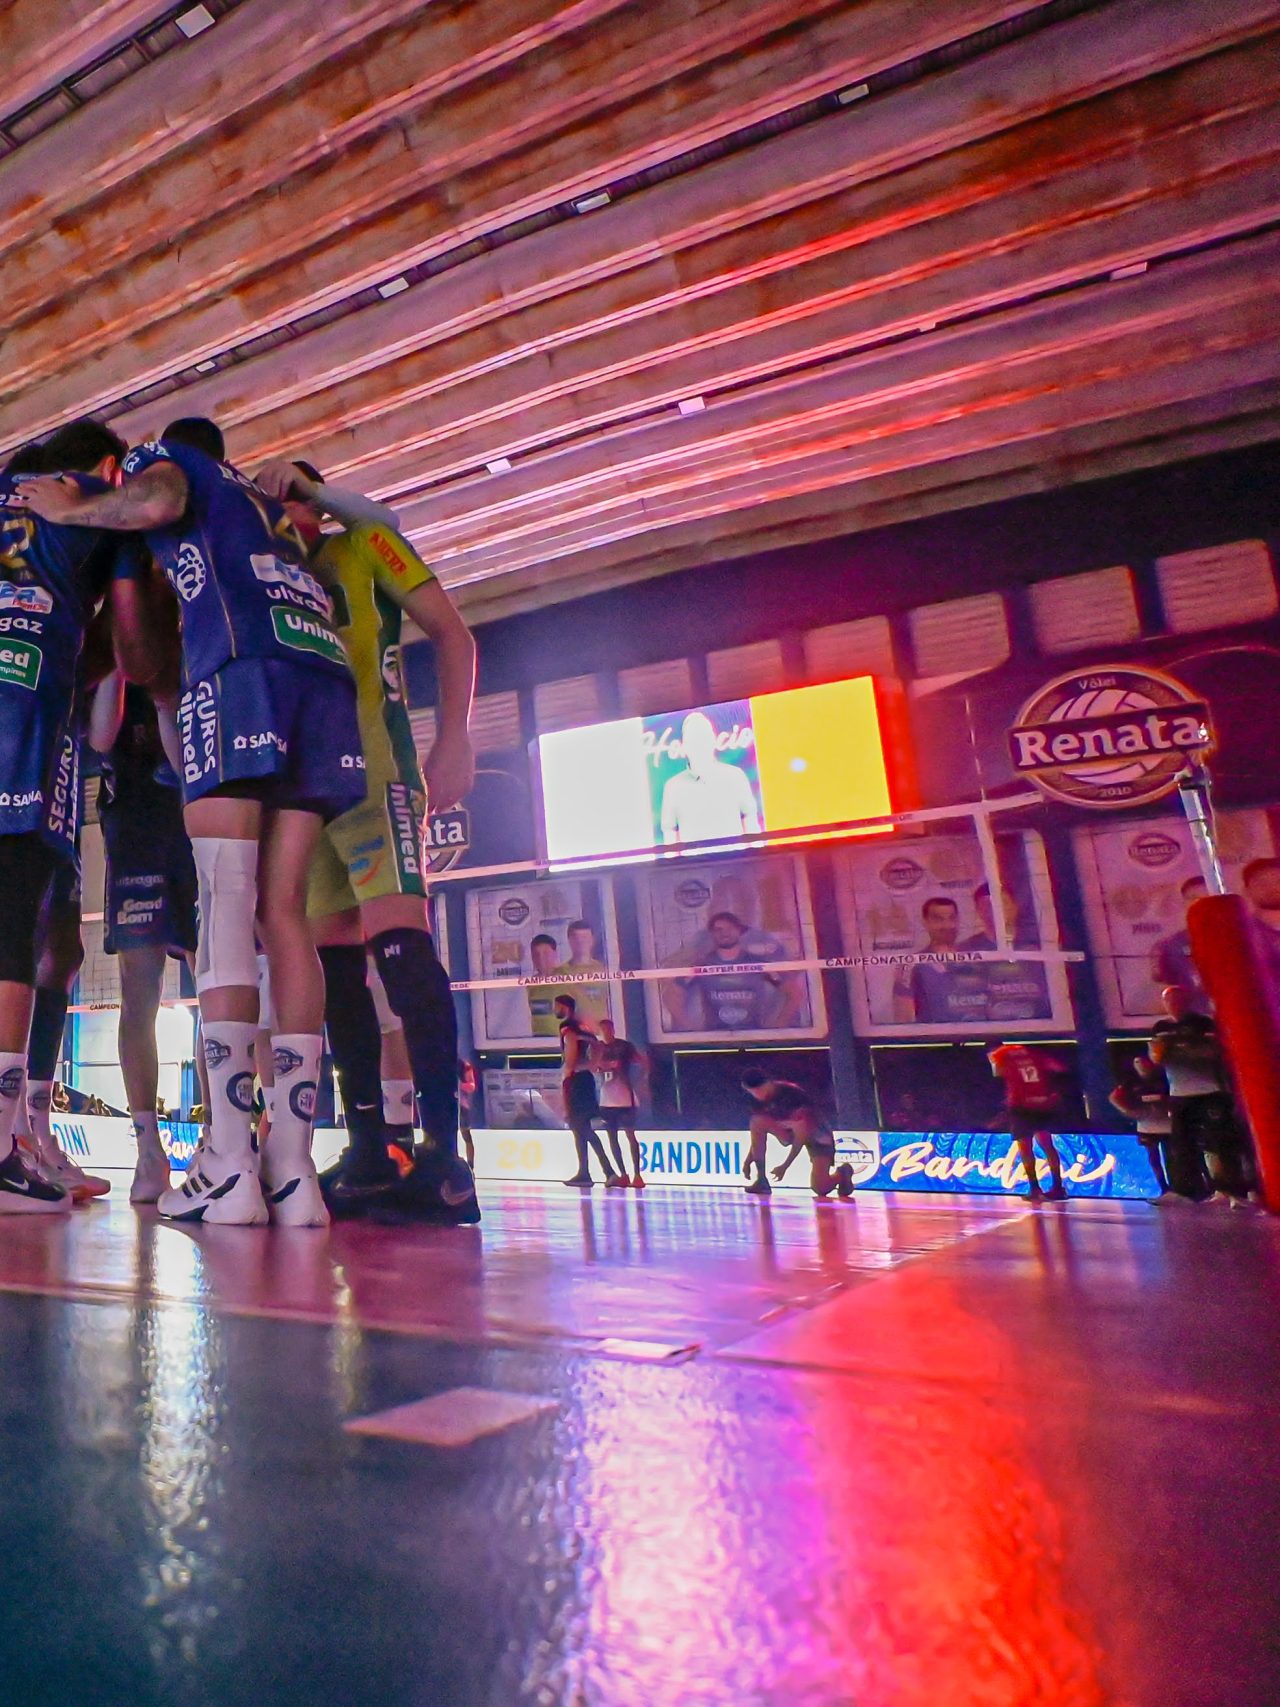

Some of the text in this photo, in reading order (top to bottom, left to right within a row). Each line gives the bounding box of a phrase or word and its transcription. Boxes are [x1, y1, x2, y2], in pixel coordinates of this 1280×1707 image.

[1013, 715, 1210, 767] Renata
[826, 952, 983, 967] CAMPEONATO PAULISTA
[517, 970, 636, 986] CAMPEONATO PAULISTA
[496, 1138, 543, 1171] 20
[639, 1141, 740, 1175] BANDINI
